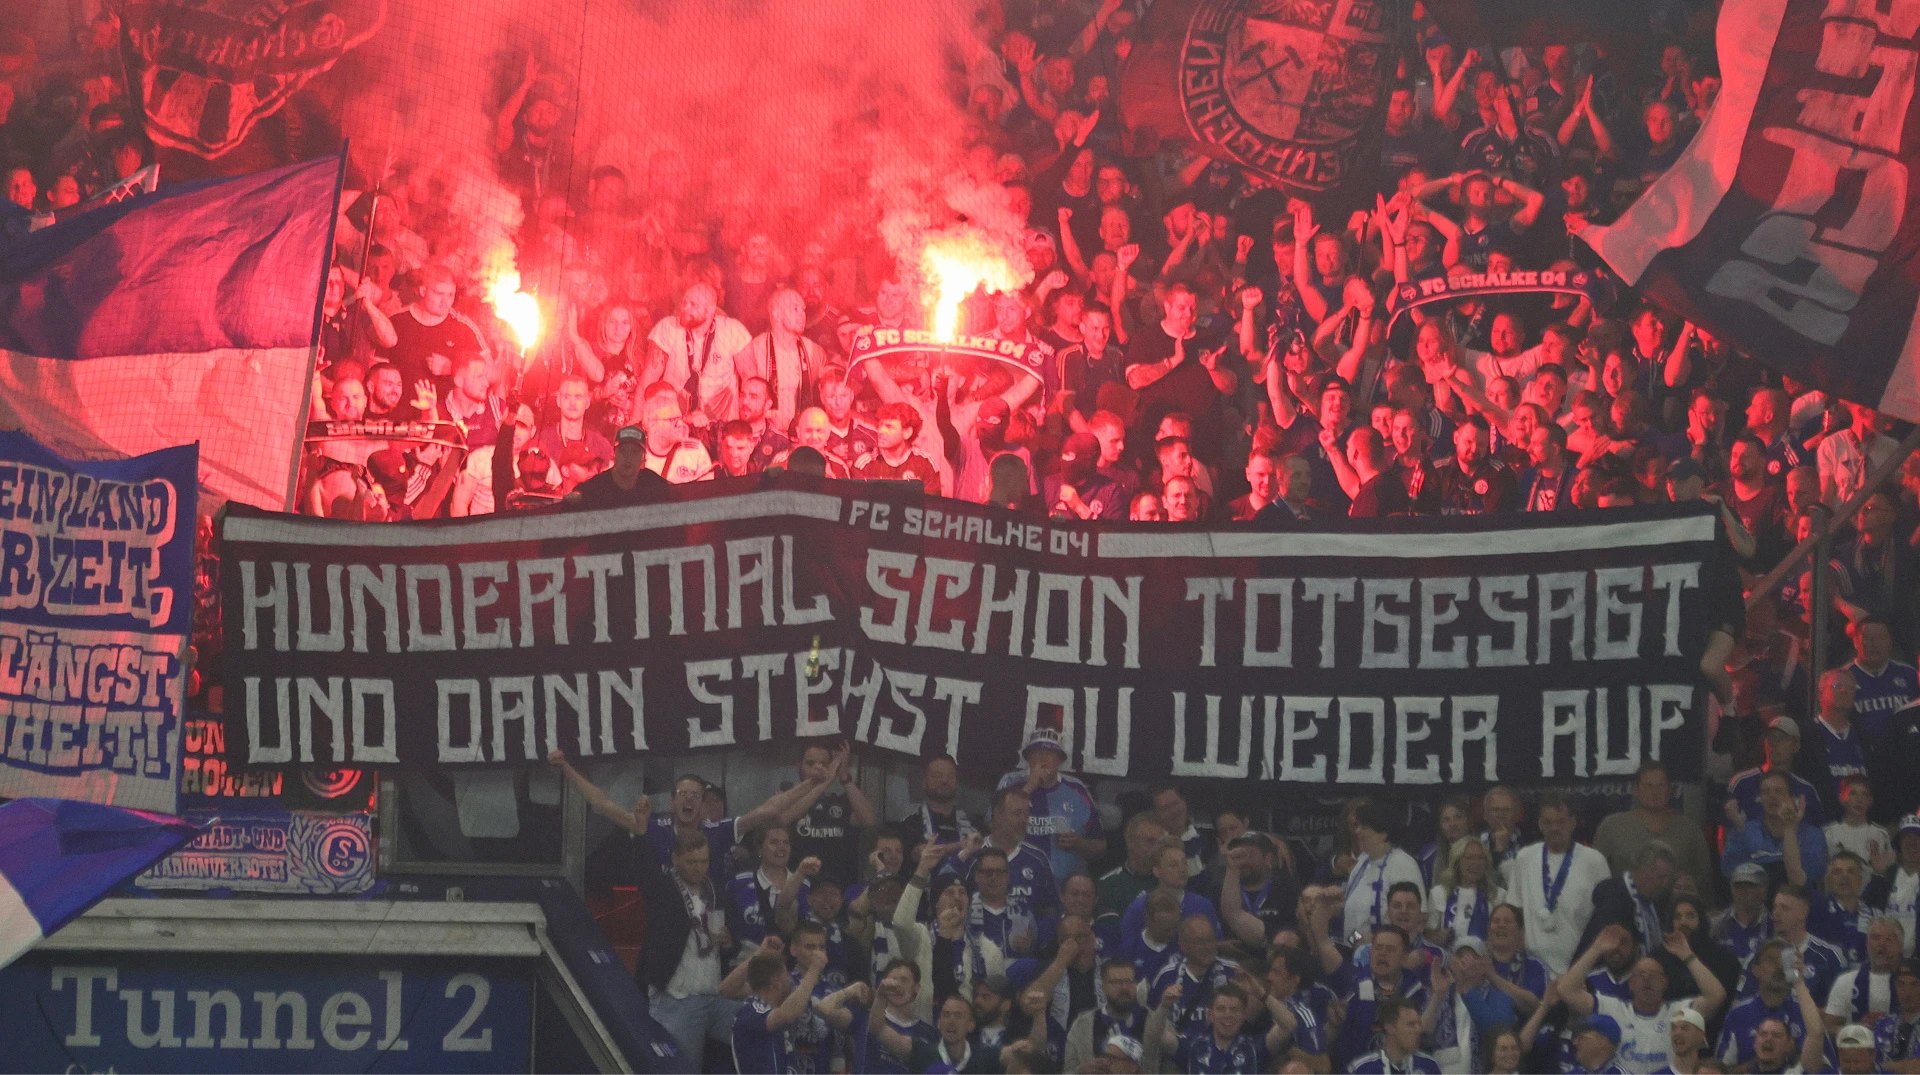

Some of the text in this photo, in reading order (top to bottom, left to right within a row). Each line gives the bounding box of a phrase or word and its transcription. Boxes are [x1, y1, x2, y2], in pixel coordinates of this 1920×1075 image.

[1419, 271, 1567, 296] FC SCHALKE 04
[873, 329, 900, 347] FC
[999, 339, 1027, 359] 04
[66, 476, 169, 536] LAND
[849, 500, 1089, 557] FC SCHALKE 04
[239, 535, 1702, 670] HUNDERTMAL SCHON TOTGESAGT
[0, 631, 169, 708] LÄNGST
[243, 648, 1695, 785] UND DANN STEHST DU WIEDER AUF
[252, 827, 287, 852] UND
[51, 966, 493, 1052] Tunnel 2
